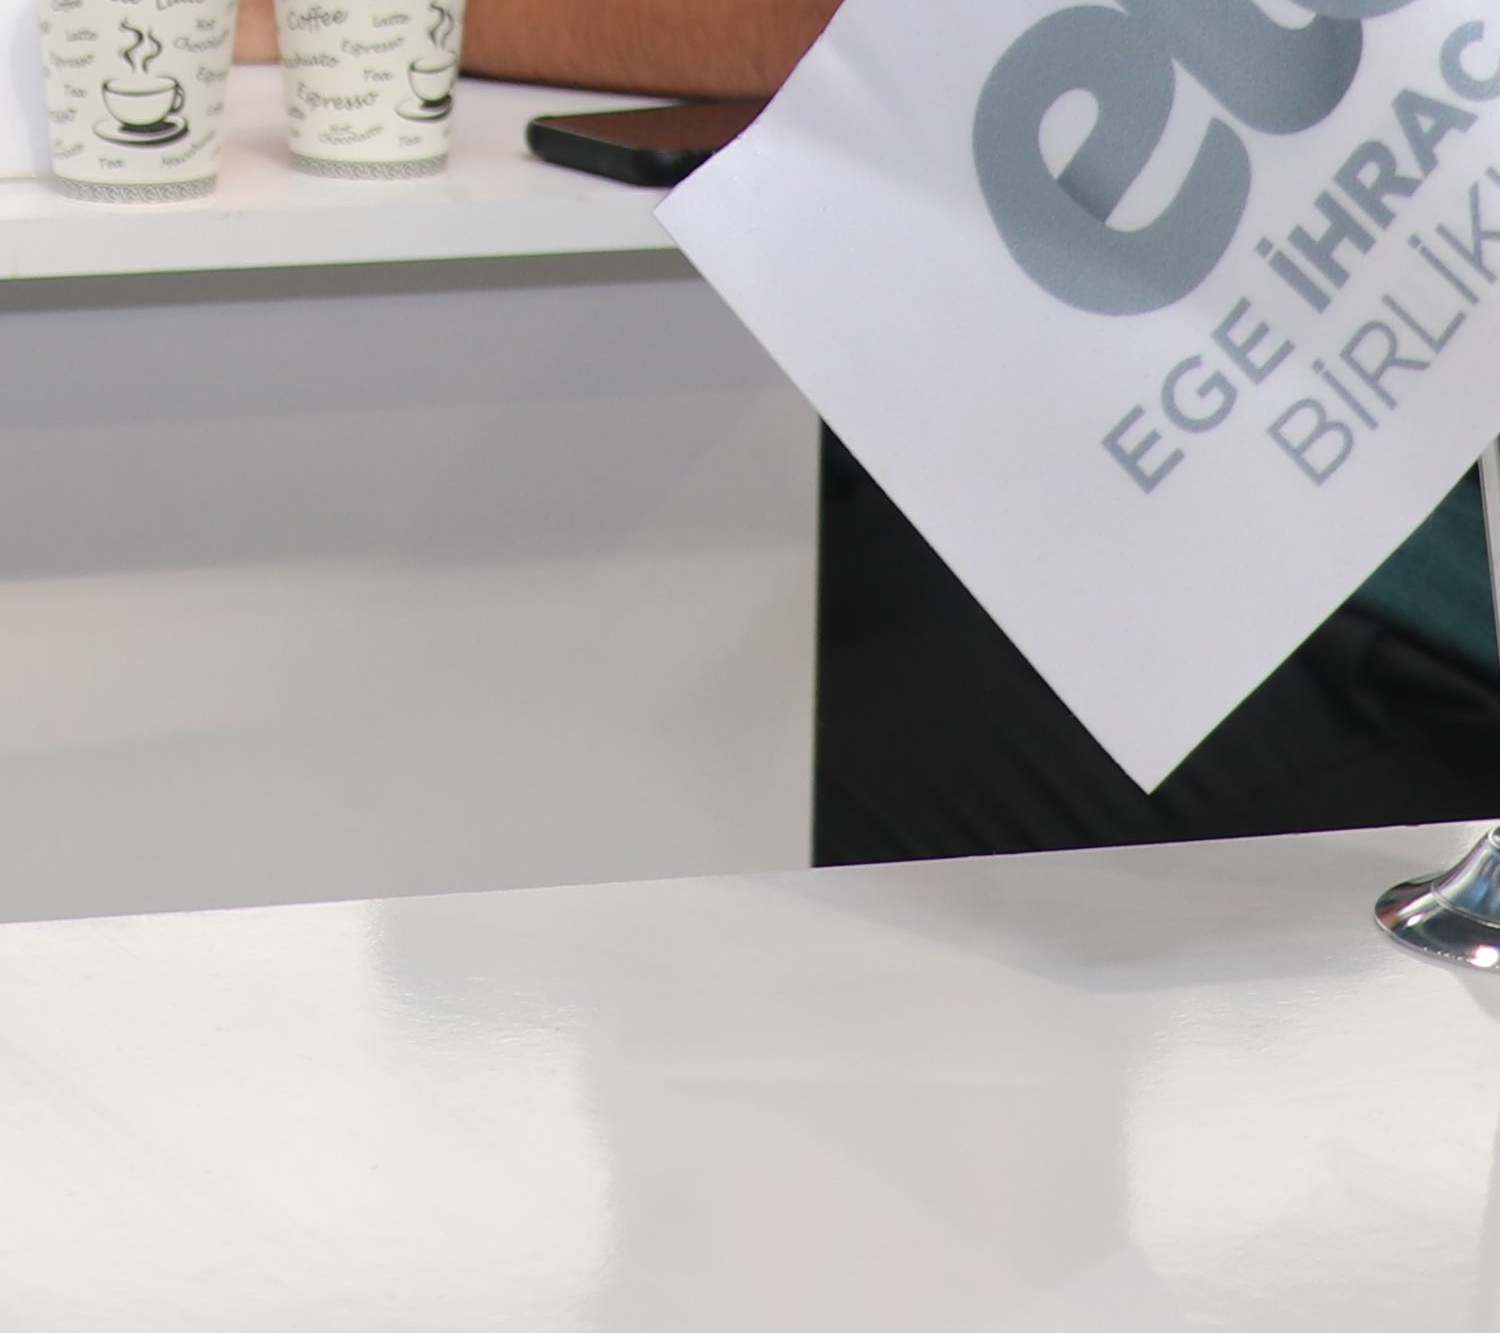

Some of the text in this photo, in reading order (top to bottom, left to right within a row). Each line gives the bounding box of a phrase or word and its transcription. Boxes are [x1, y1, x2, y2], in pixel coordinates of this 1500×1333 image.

[288, 6, 348, 32] Coffee
[297, 82, 380, 111] Espresso
[1100, 298, 1296, 495] EGE
